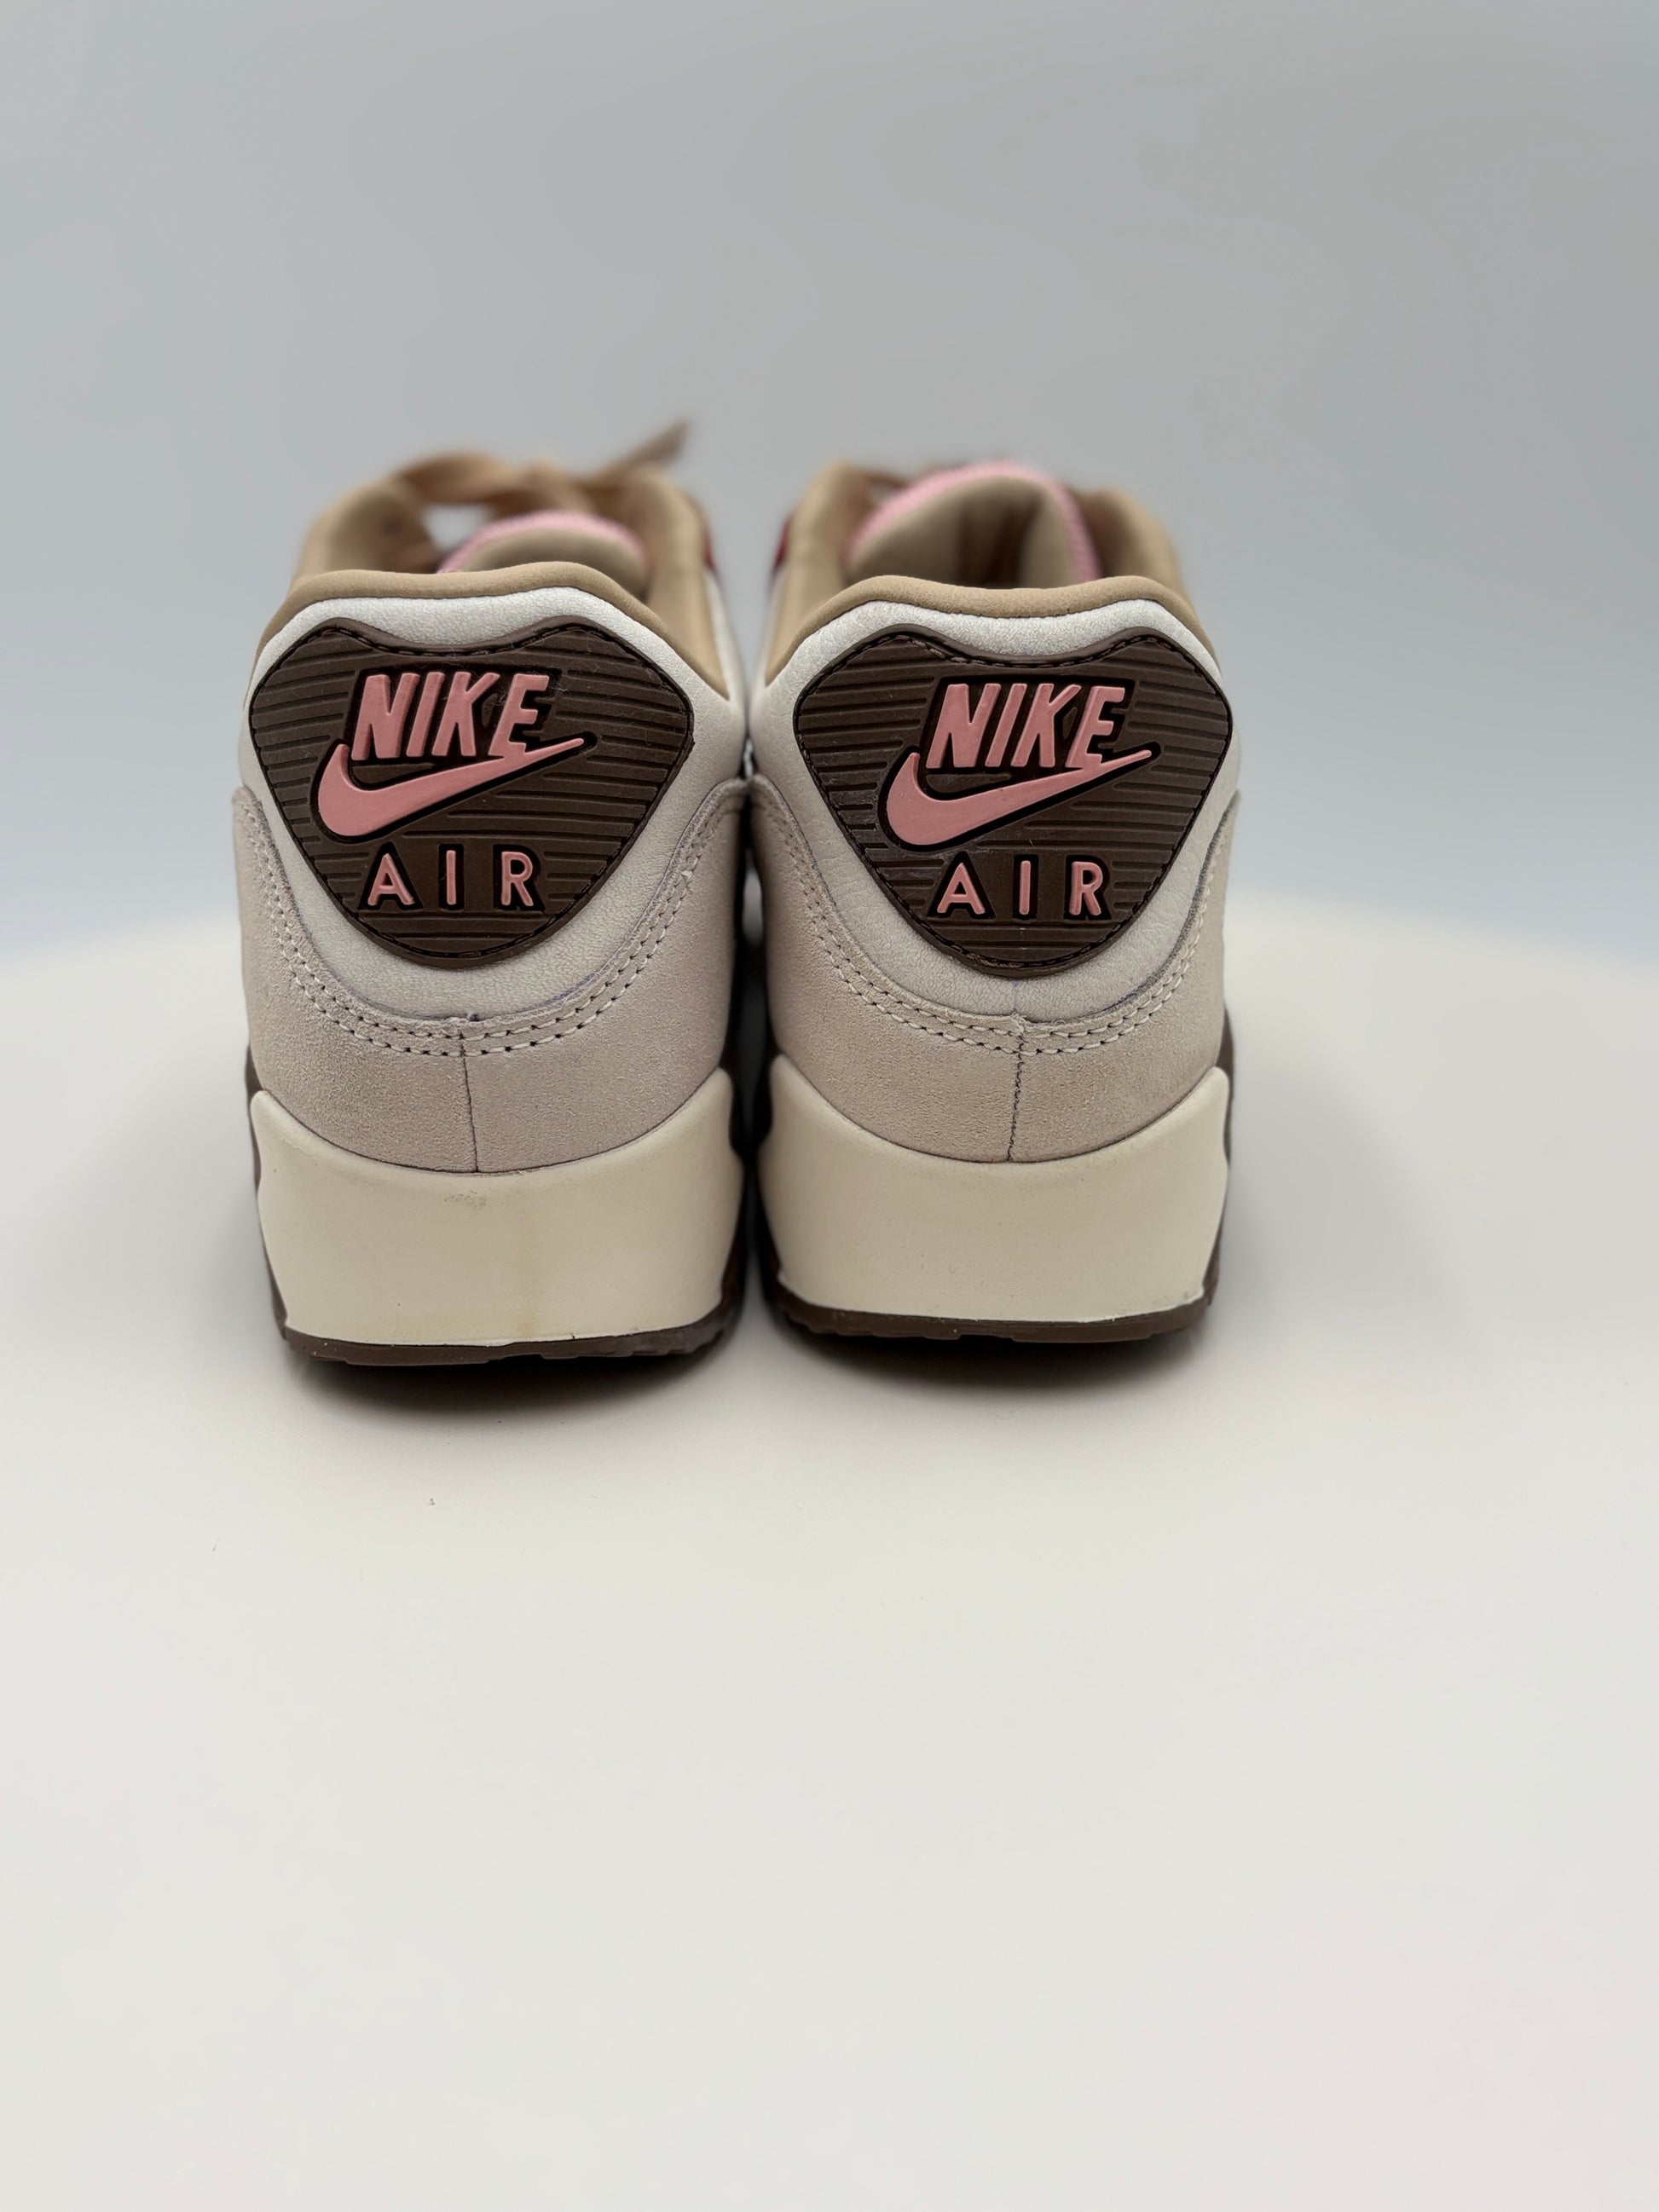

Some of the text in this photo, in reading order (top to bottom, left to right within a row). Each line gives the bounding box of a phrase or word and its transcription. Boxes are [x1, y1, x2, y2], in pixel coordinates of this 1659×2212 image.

[350, 671, 551, 760] NIKE
[925, 682, 1125, 770] NIKE
[367, 849, 537, 907] AIR
[936, 860, 1104, 915] AIR
